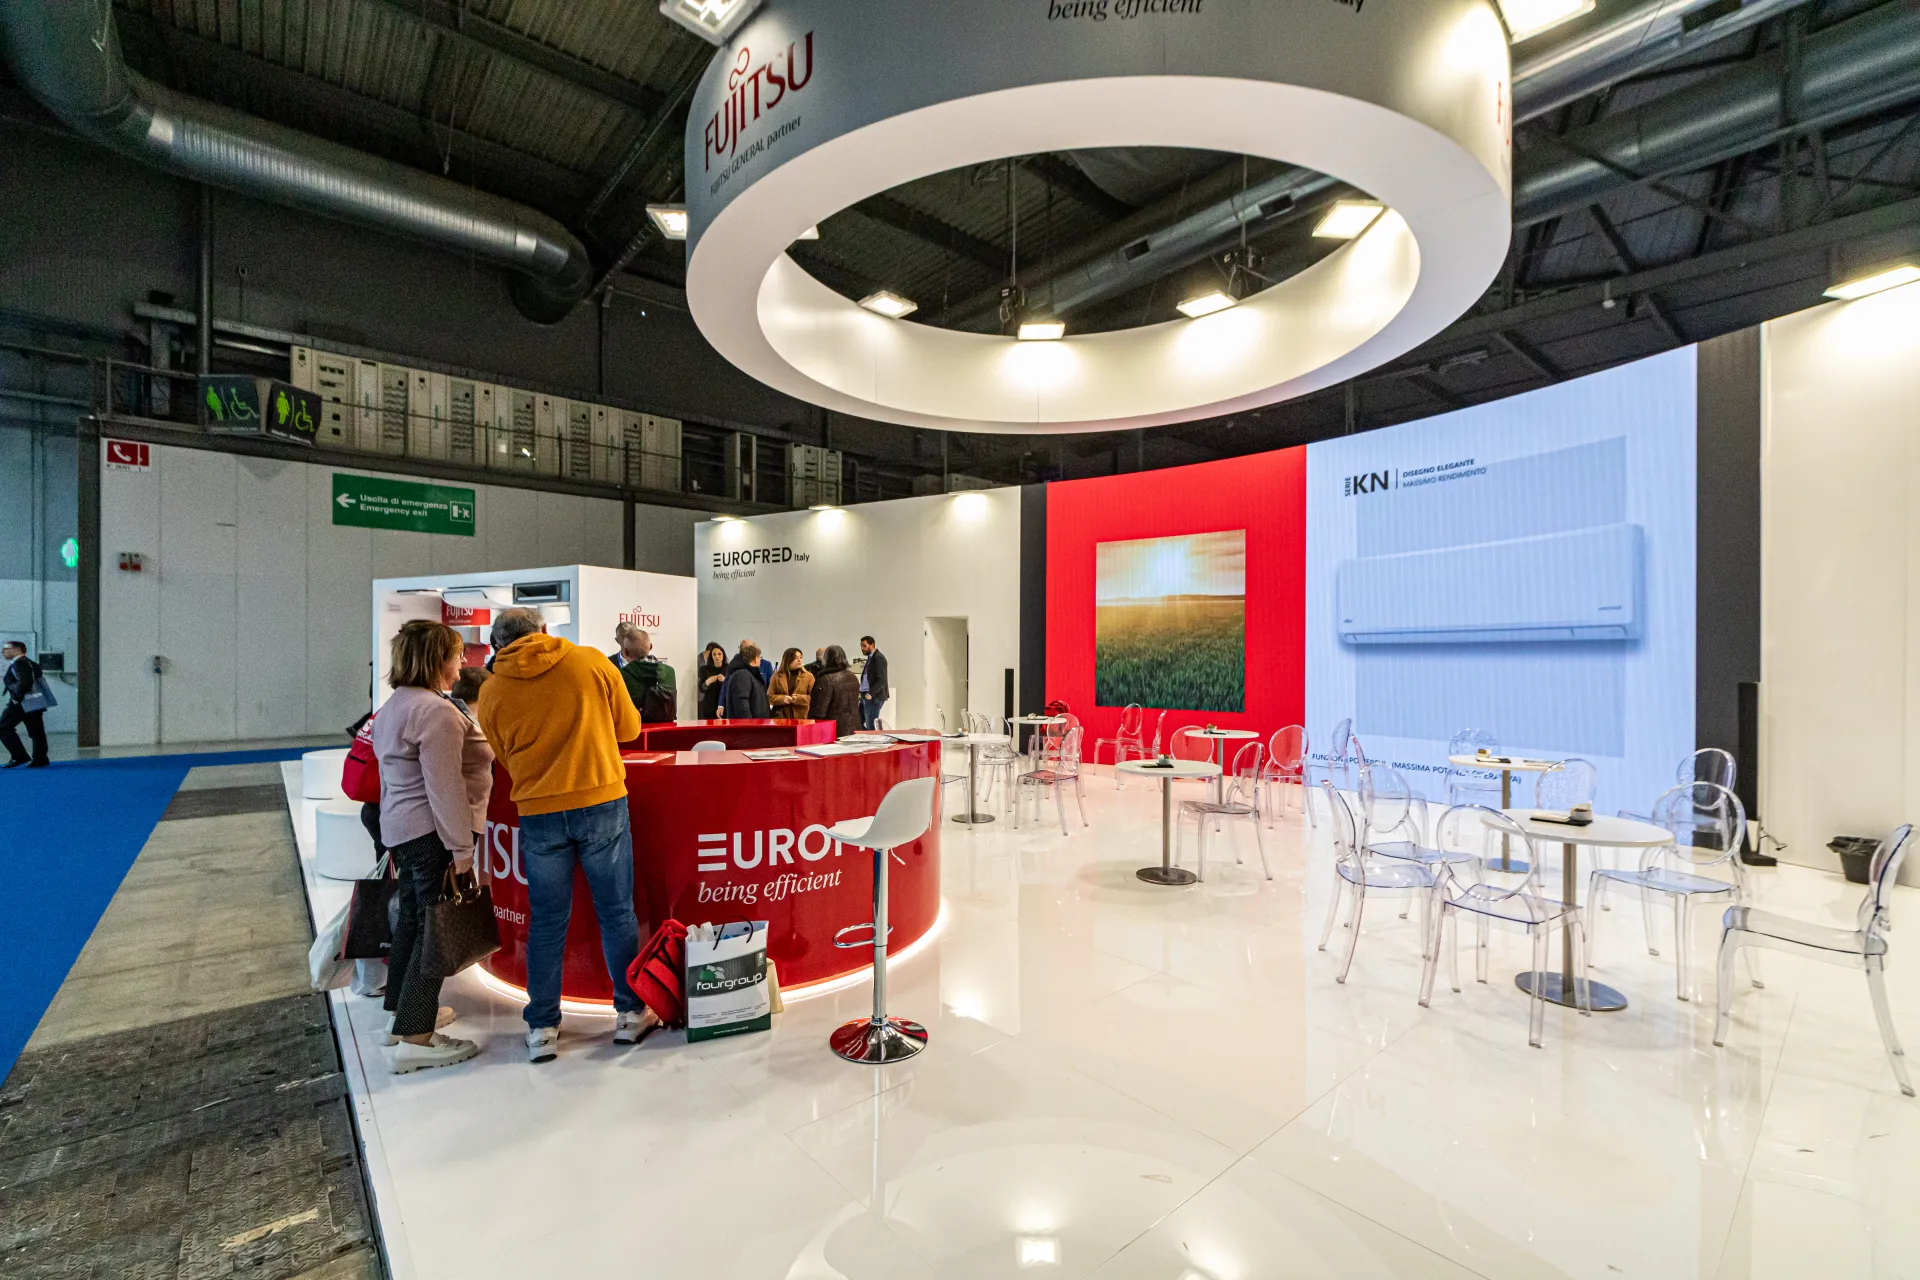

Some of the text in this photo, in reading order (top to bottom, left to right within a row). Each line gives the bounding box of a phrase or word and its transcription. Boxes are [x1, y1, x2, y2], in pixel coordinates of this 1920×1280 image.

[704, 31, 814, 173] FUJITSU
[731, 138, 765, 175] GENERAL
[766, 116, 803, 150] partner
[1402, 458, 1475, 478] DISEGNO ELEGANTE
[1402, 467, 1487, 488] MASSIMO RENDIMENTO
[1353, 470, 1389, 495] KN
[360, 494, 448, 510] Uscita di emergenza
[360, 503, 428, 517] Emergency exit
[713, 547, 810, 567] EUROFRED Italy
[713, 569, 756, 581] being efficient
[698, 869, 843, 905] being efficient
[696, 972, 763, 990] fourgroup
